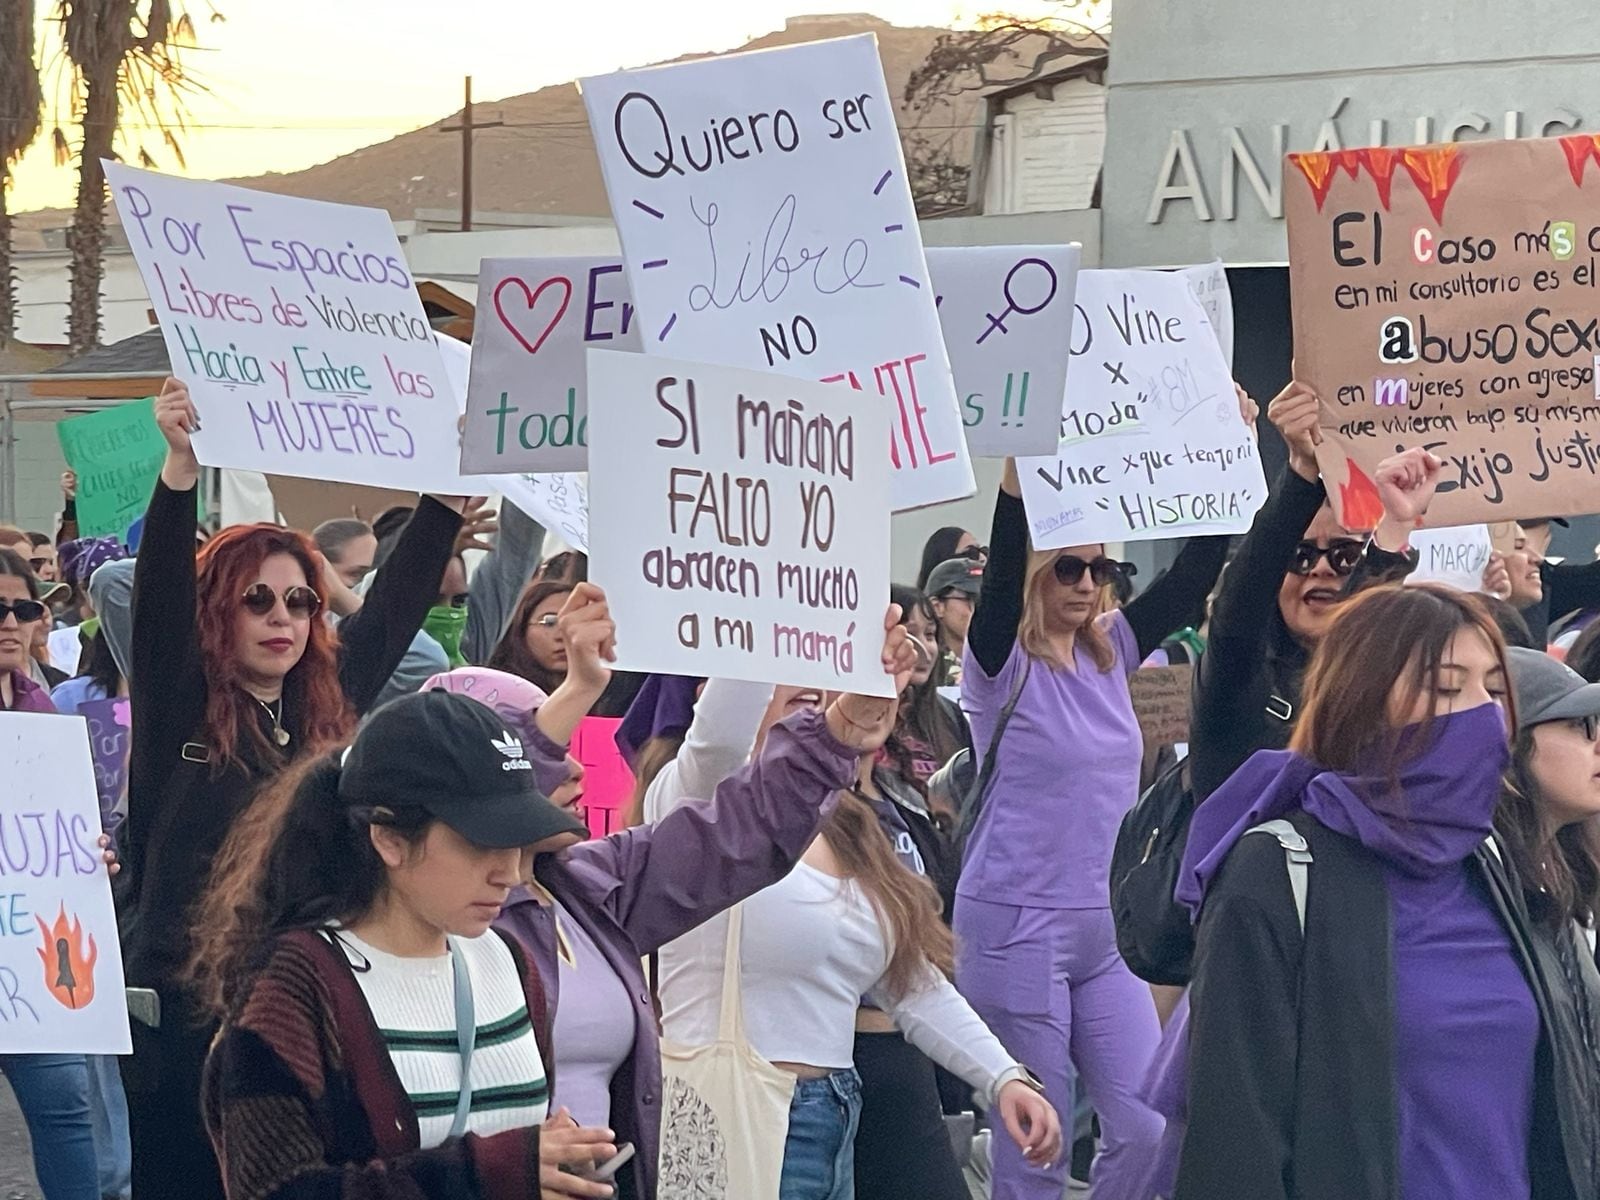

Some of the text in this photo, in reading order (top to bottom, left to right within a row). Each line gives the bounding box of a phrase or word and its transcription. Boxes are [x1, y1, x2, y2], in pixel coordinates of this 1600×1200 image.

[614, 92, 874, 178] Quiero ser
[121, 186, 411, 293] Por Espacios
[688, 194, 887, 311] Libre
[1332, 212, 1382, 267] El
[1514, 221, 1573, 255] más
[153, 263, 263, 318] Libres
[270, 287, 308, 328] de
[1335, 256, 1595, 309] en mi consultorio es el
[759, 315, 817, 366] NO
[1107, 292, 1187, 347] Vine
[1382, 308, 1600, 364] abuso Sex
[174, 324, 435, 399] Hacia y Entre las
[1337, 365, 1600, 410] en mujeres con agreso
[247, 402, 415, 459] MUJERES
[737, 394, 854, 482] mañana
[1339, 417, 1376, 439] que
[1037, 459, 1112, 492] Vine
[668, 467, 771, 547] FALTO
[799, 480, 835, 553] YO
[642, 549, 760, 598] abracen
[773, 621, 856, 677] mamá
[0, 809, 97, 878] UJAS
